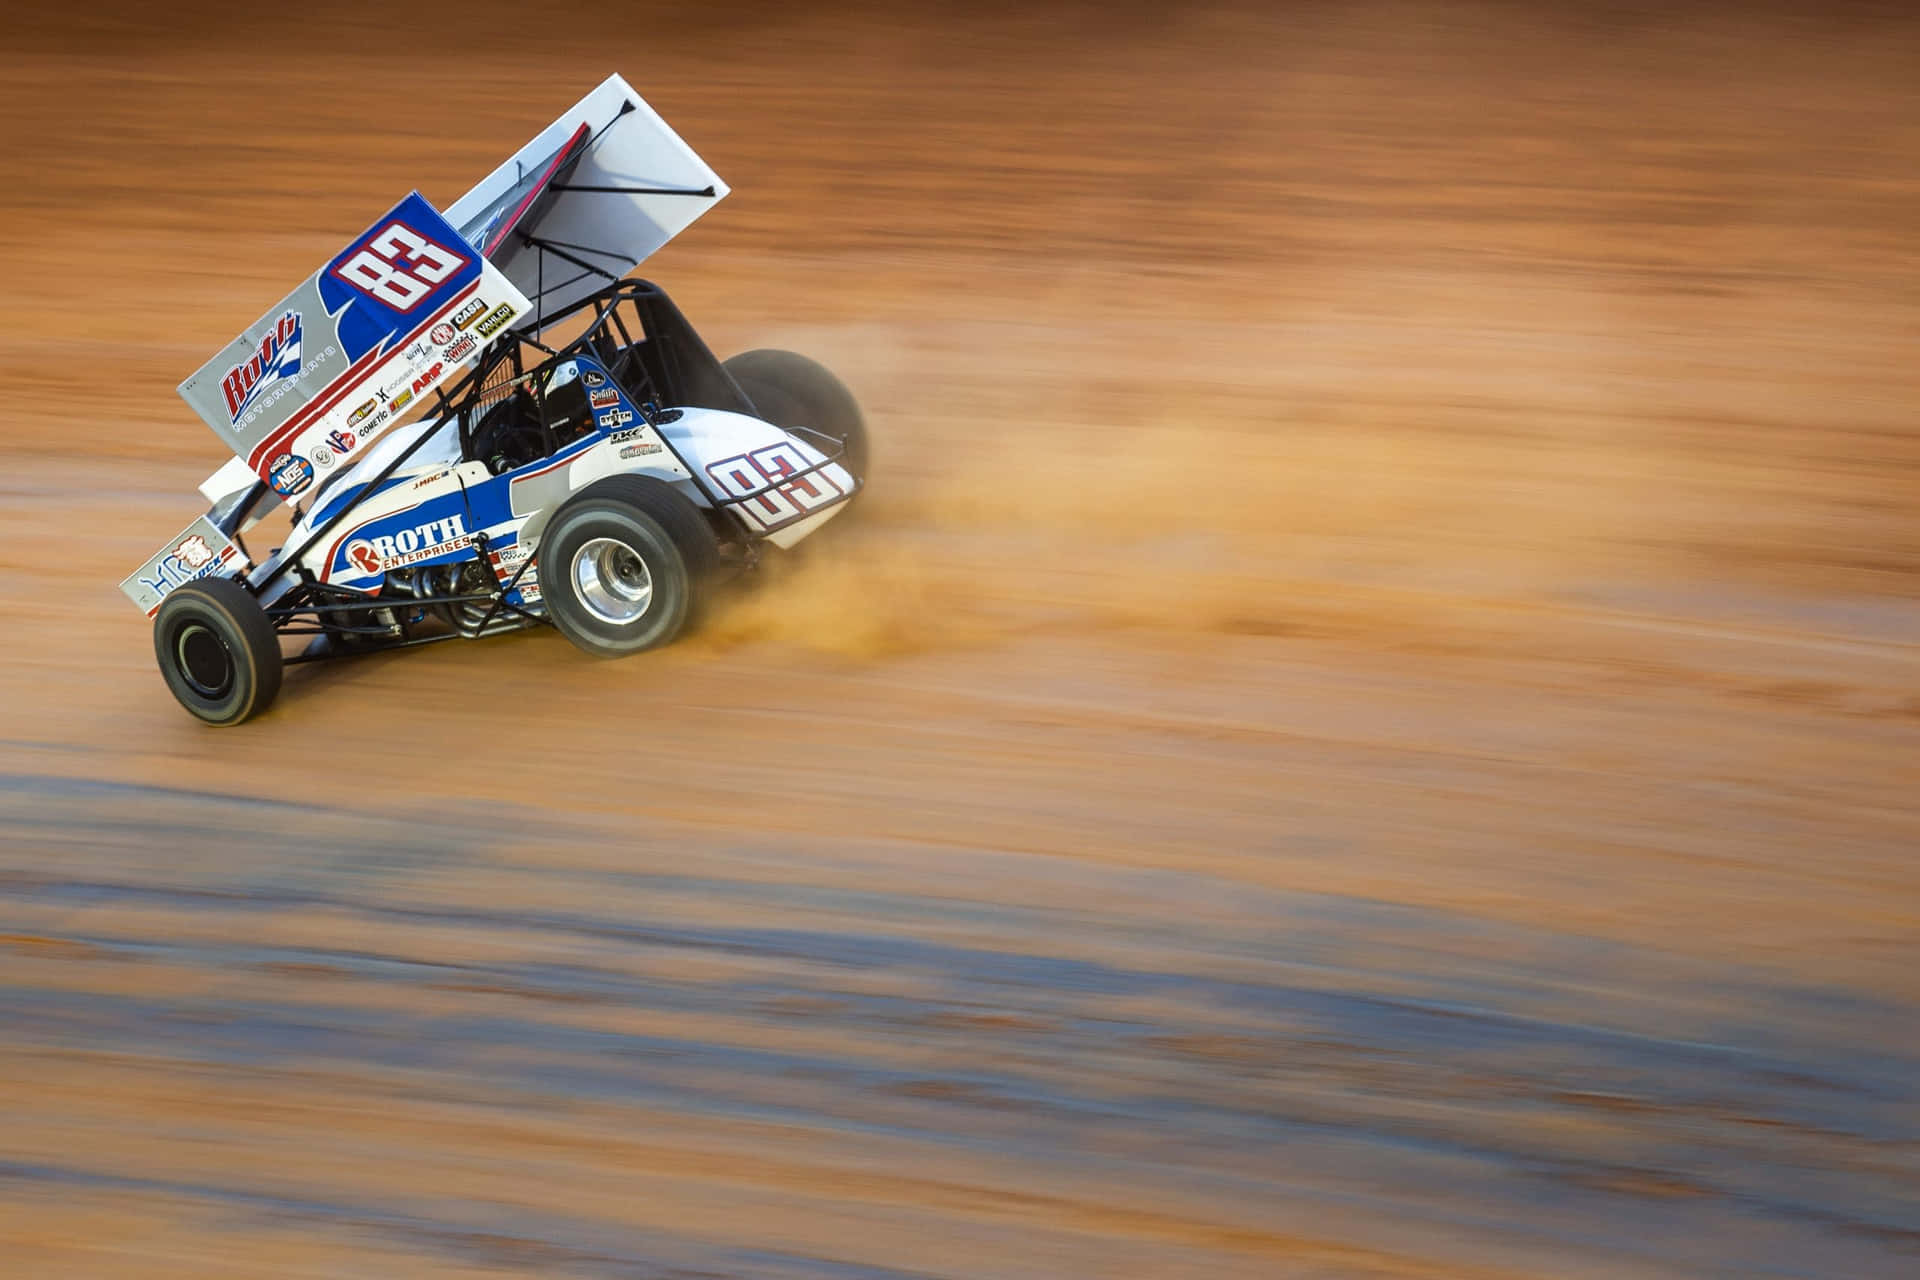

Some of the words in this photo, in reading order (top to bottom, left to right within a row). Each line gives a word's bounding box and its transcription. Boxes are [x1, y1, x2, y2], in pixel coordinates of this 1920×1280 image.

[333, 221, 468, 313] 83
[455, 299, 484, 325] CASE
[220, 309, 302, 420] Roth
[233, 345, 337, 432] MOTORSPORTS
[359, 410, 388, 437] COMETIC
[600, 412, 631, 424] SYSTEM
[277, 460, 306, 491] NOS
[706, 442, 846, 529] 83
[371, 513, 468, 561] ROTH
[383, 536, 472, 569] ENTERPRISES
